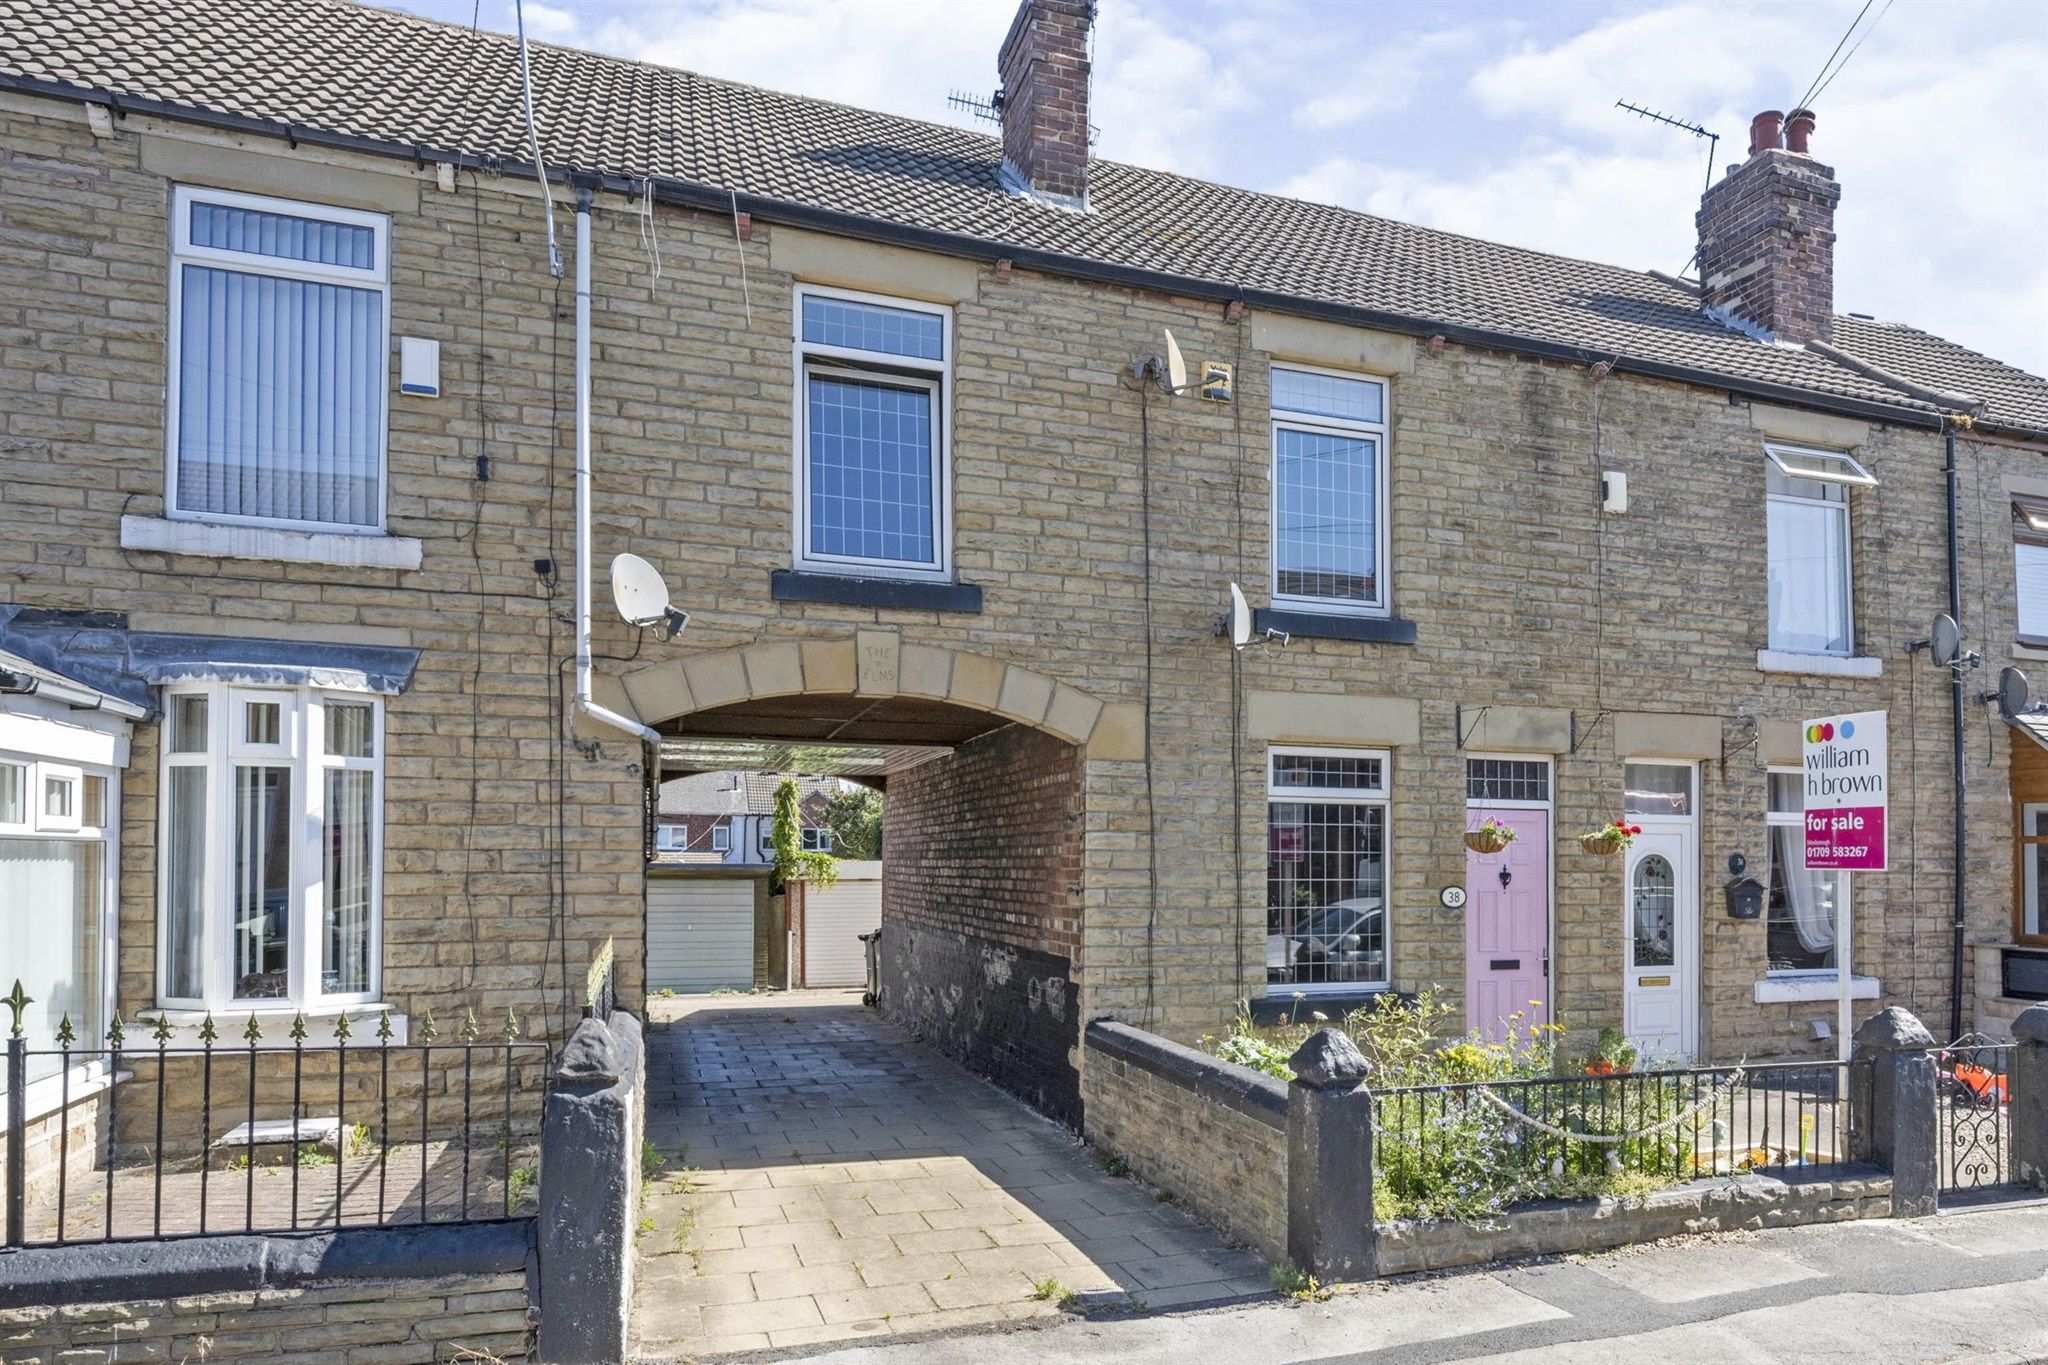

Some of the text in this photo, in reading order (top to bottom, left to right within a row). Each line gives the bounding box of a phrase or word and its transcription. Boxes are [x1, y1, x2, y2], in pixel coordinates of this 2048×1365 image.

[864, 646, 893, 659] THE
[863, 669, 896, 681] ELMS
[1806, 745, 1869, 770] william
[1808, 772, 1882, 796] h brown
[1806, 812, 1864, 831] for sale
[1807, 846, 1868, 857] 01709 583267
[1448, 891, 1460, 903] 38
